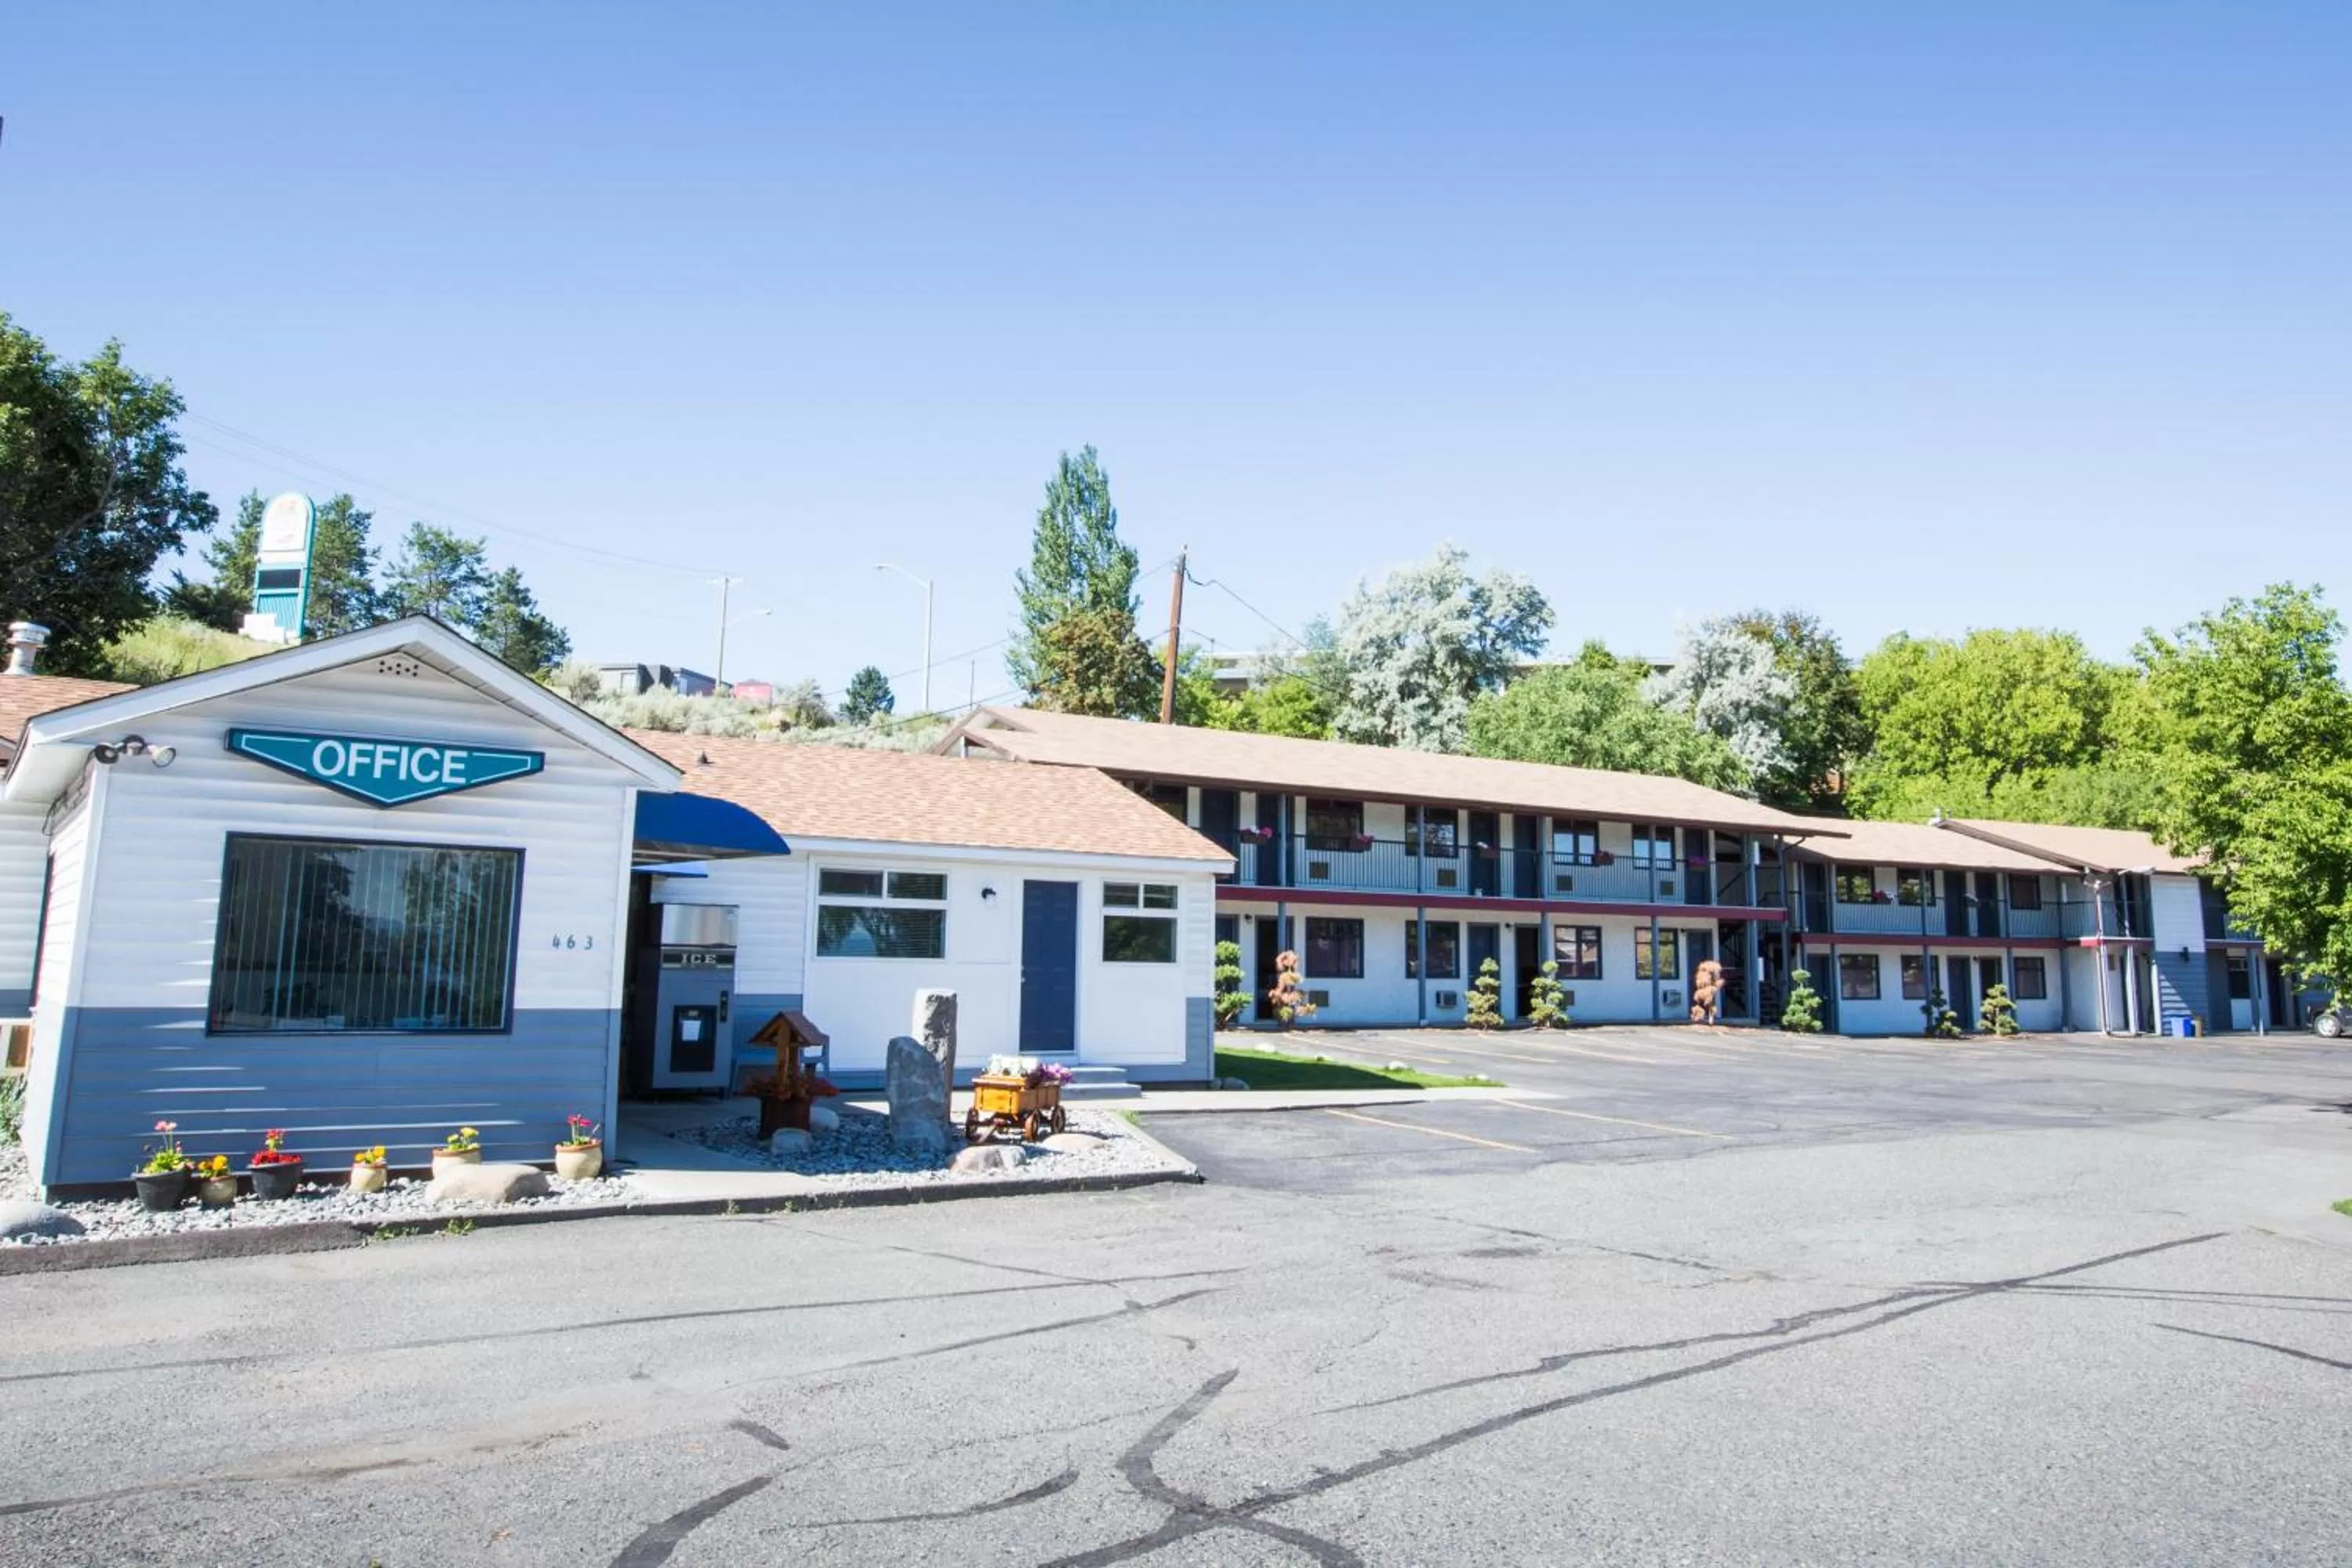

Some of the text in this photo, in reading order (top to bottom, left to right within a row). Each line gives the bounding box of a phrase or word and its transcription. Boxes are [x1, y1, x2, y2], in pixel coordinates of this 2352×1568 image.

[313, 739, 469, 783] OFFICE
[552, 934, 593, 950] 463
[681, 953, 716, 964] ICE
